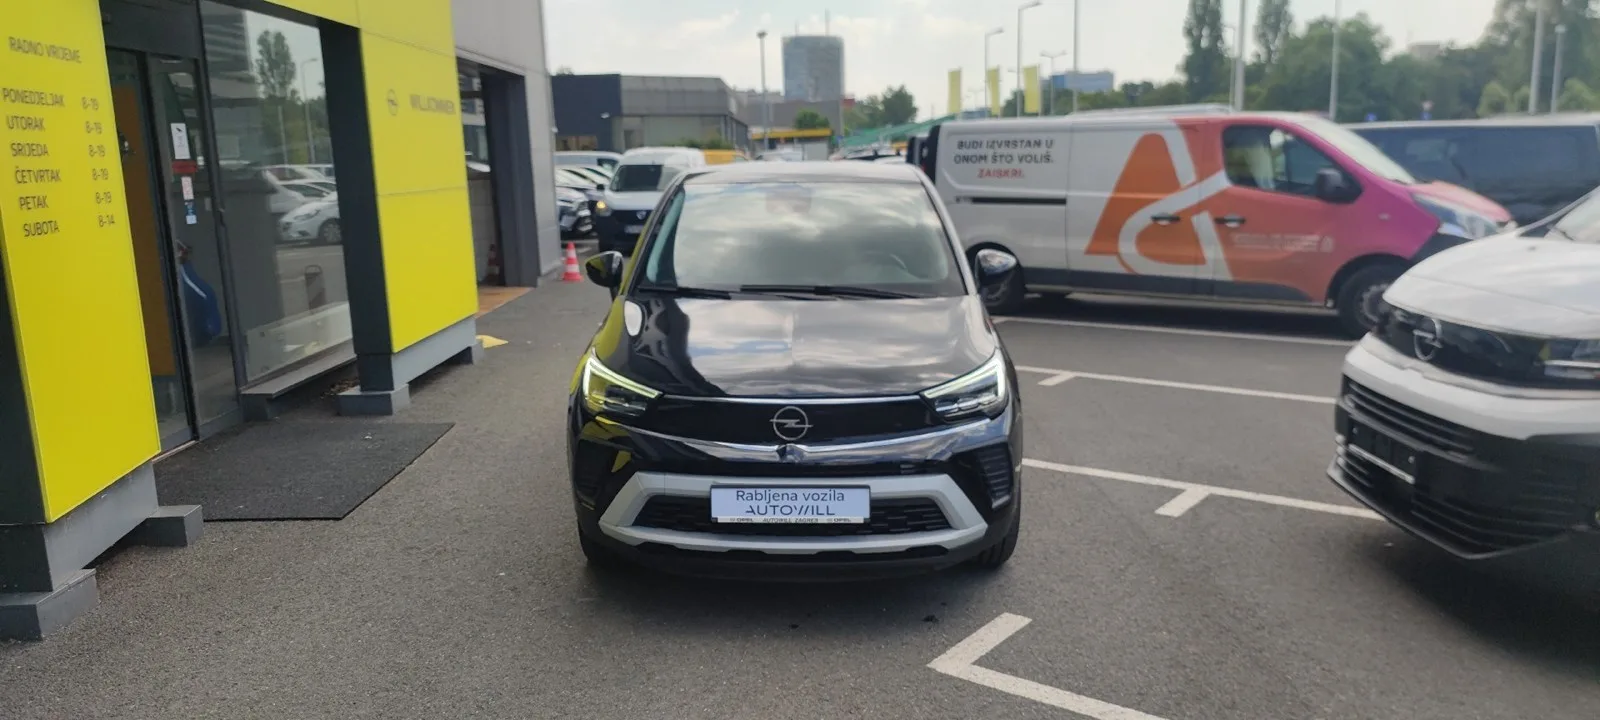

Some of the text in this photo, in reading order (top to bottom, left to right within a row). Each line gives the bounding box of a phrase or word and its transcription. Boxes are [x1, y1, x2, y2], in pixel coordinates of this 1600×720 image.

[8, 36, 82, 64] RADNO VRIJEME
[2, 87, 65, 107] PONEDJELJAK
[6, 115, 45, 131] UTORAK
[10, 142, 106, 158] SRIJEDA 8-19
[957, 138, 1054, 150] BUDI IZVRSTAN U
[953, 154, 988, 165] ONOM
[991, 151, 1014, 164] ŠTO
[15, 166, 109, 185] ČETVRTAK 8-19
[19, 191, 112, 211] PETAK 8-19
[23, 215, 116, 238] SUBOTA 8-14
[735, 489, 846, 504] Rabljena vozila
